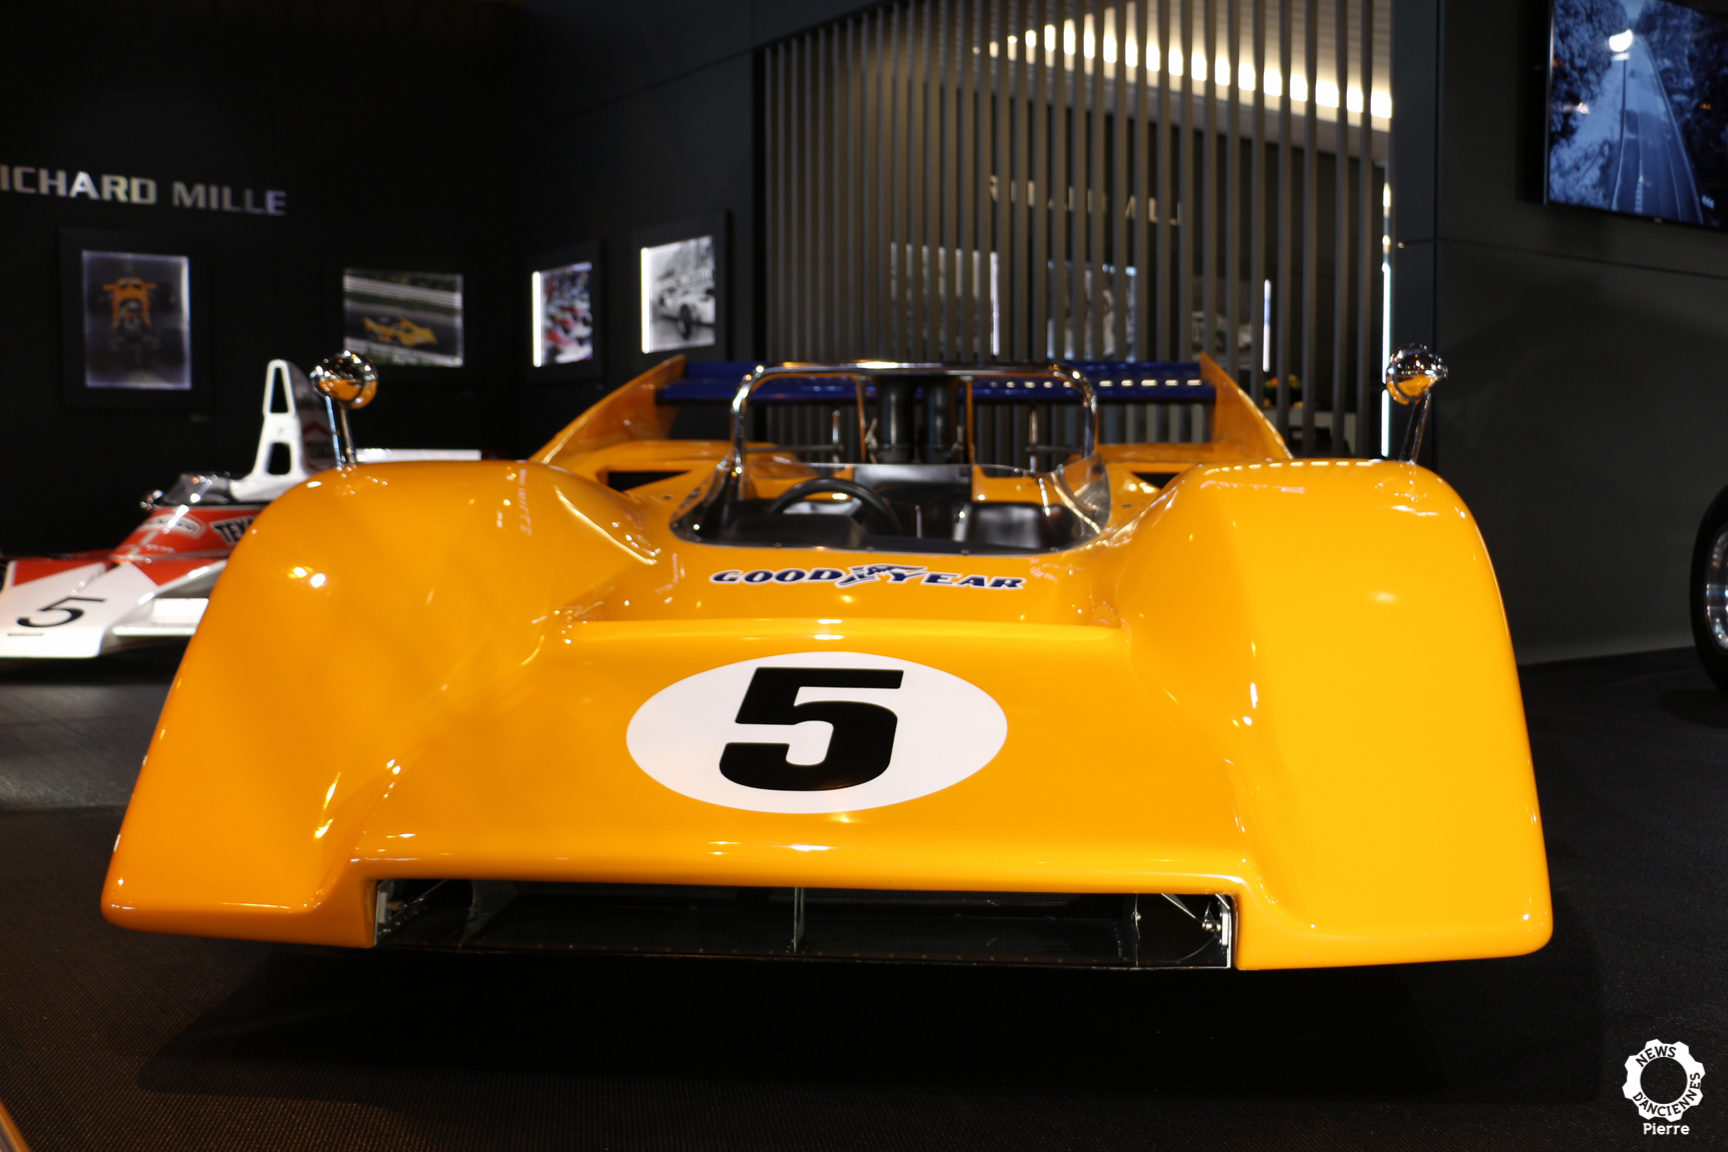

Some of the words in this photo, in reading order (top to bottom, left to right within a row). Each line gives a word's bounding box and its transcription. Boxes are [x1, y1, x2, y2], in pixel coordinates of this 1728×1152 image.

[173, 181, 287, 216] MILLE
[16, 596, 107, 628] 5
[719, 667, 904, 791] 5
